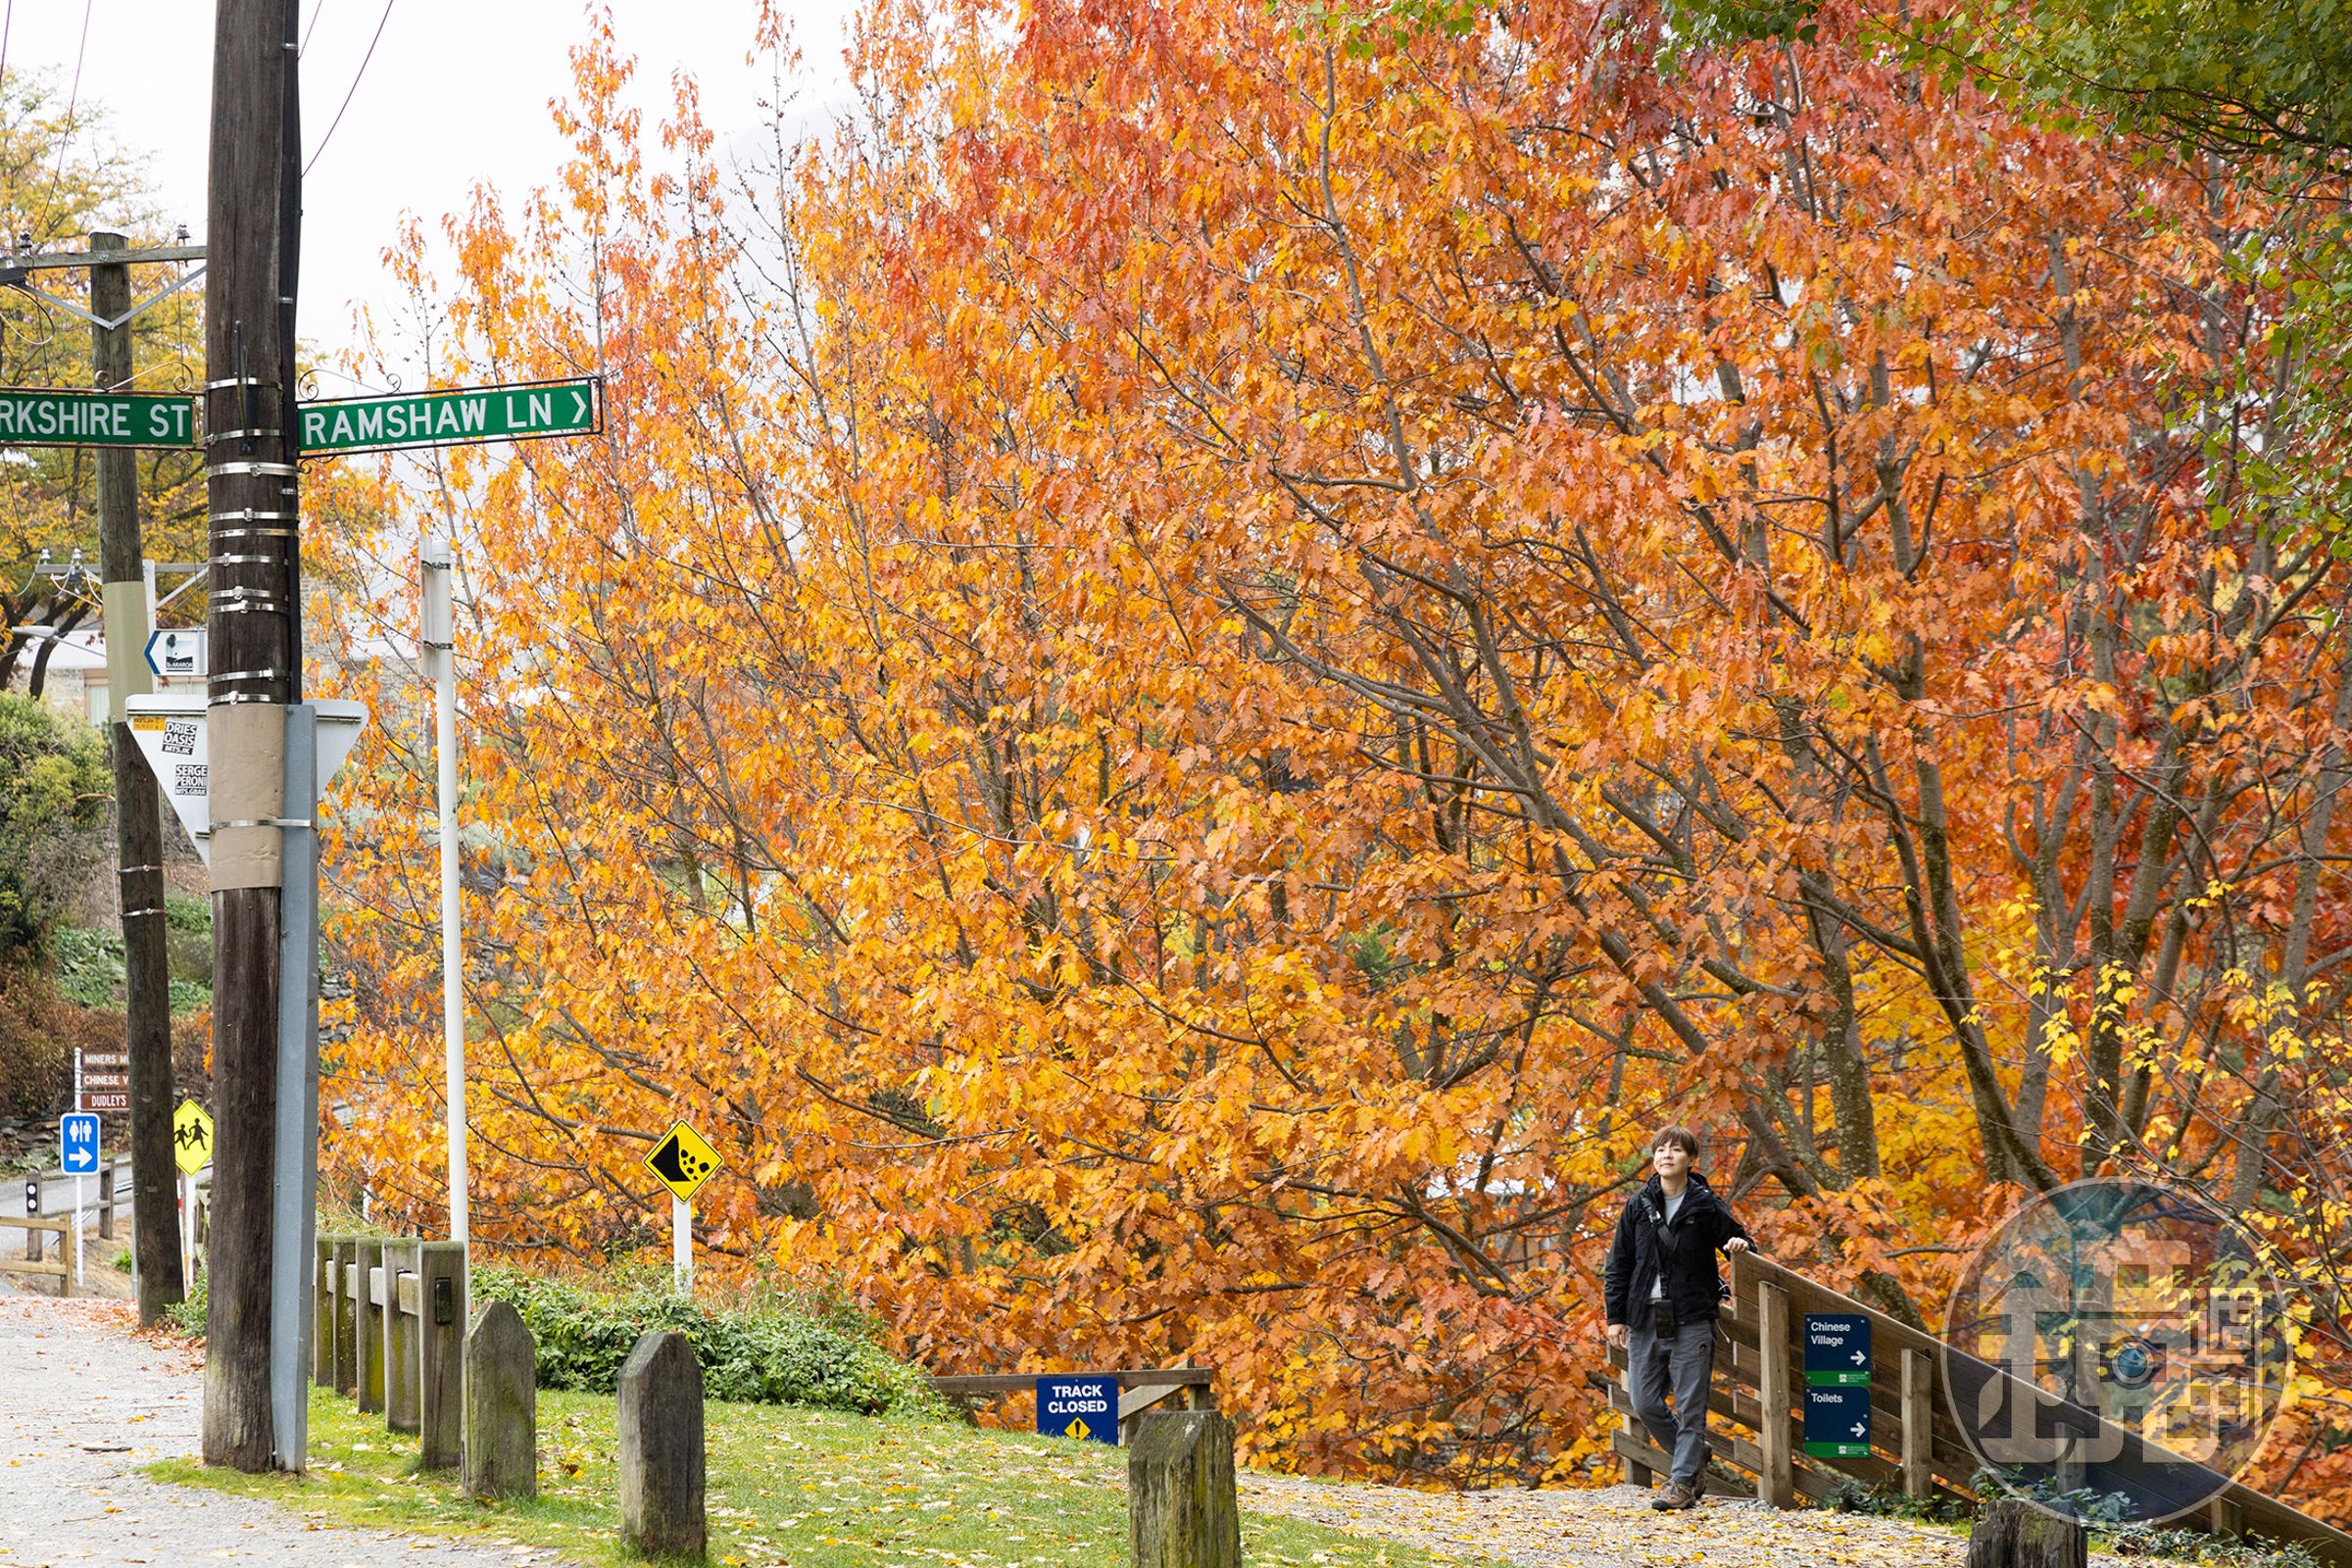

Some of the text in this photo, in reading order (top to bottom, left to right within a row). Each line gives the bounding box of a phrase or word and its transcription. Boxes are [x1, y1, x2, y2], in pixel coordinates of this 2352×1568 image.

[0, 400, 189, 437] RKSHIRE ST
[305, 393, 551, 445] RAMSHAW LN
[166, 722, 197, 736] DRIES
[164, 732, 195, 746] OASIS
[176, 765, 208, 776] SERGE
[84, 1054, 117, 1064] MINERS
[83, 1074, 120, 1085] CHINESE
[1811, 1322, 1851, 1332] Chinese
[1811, 1335, 1844, 1348] Village
[1053, 1385, 1102, 1397] TRACK
[1811, 1393, 1843, 1403] Toilets
[1048, 1400, 1107, 1413] CLOSED
